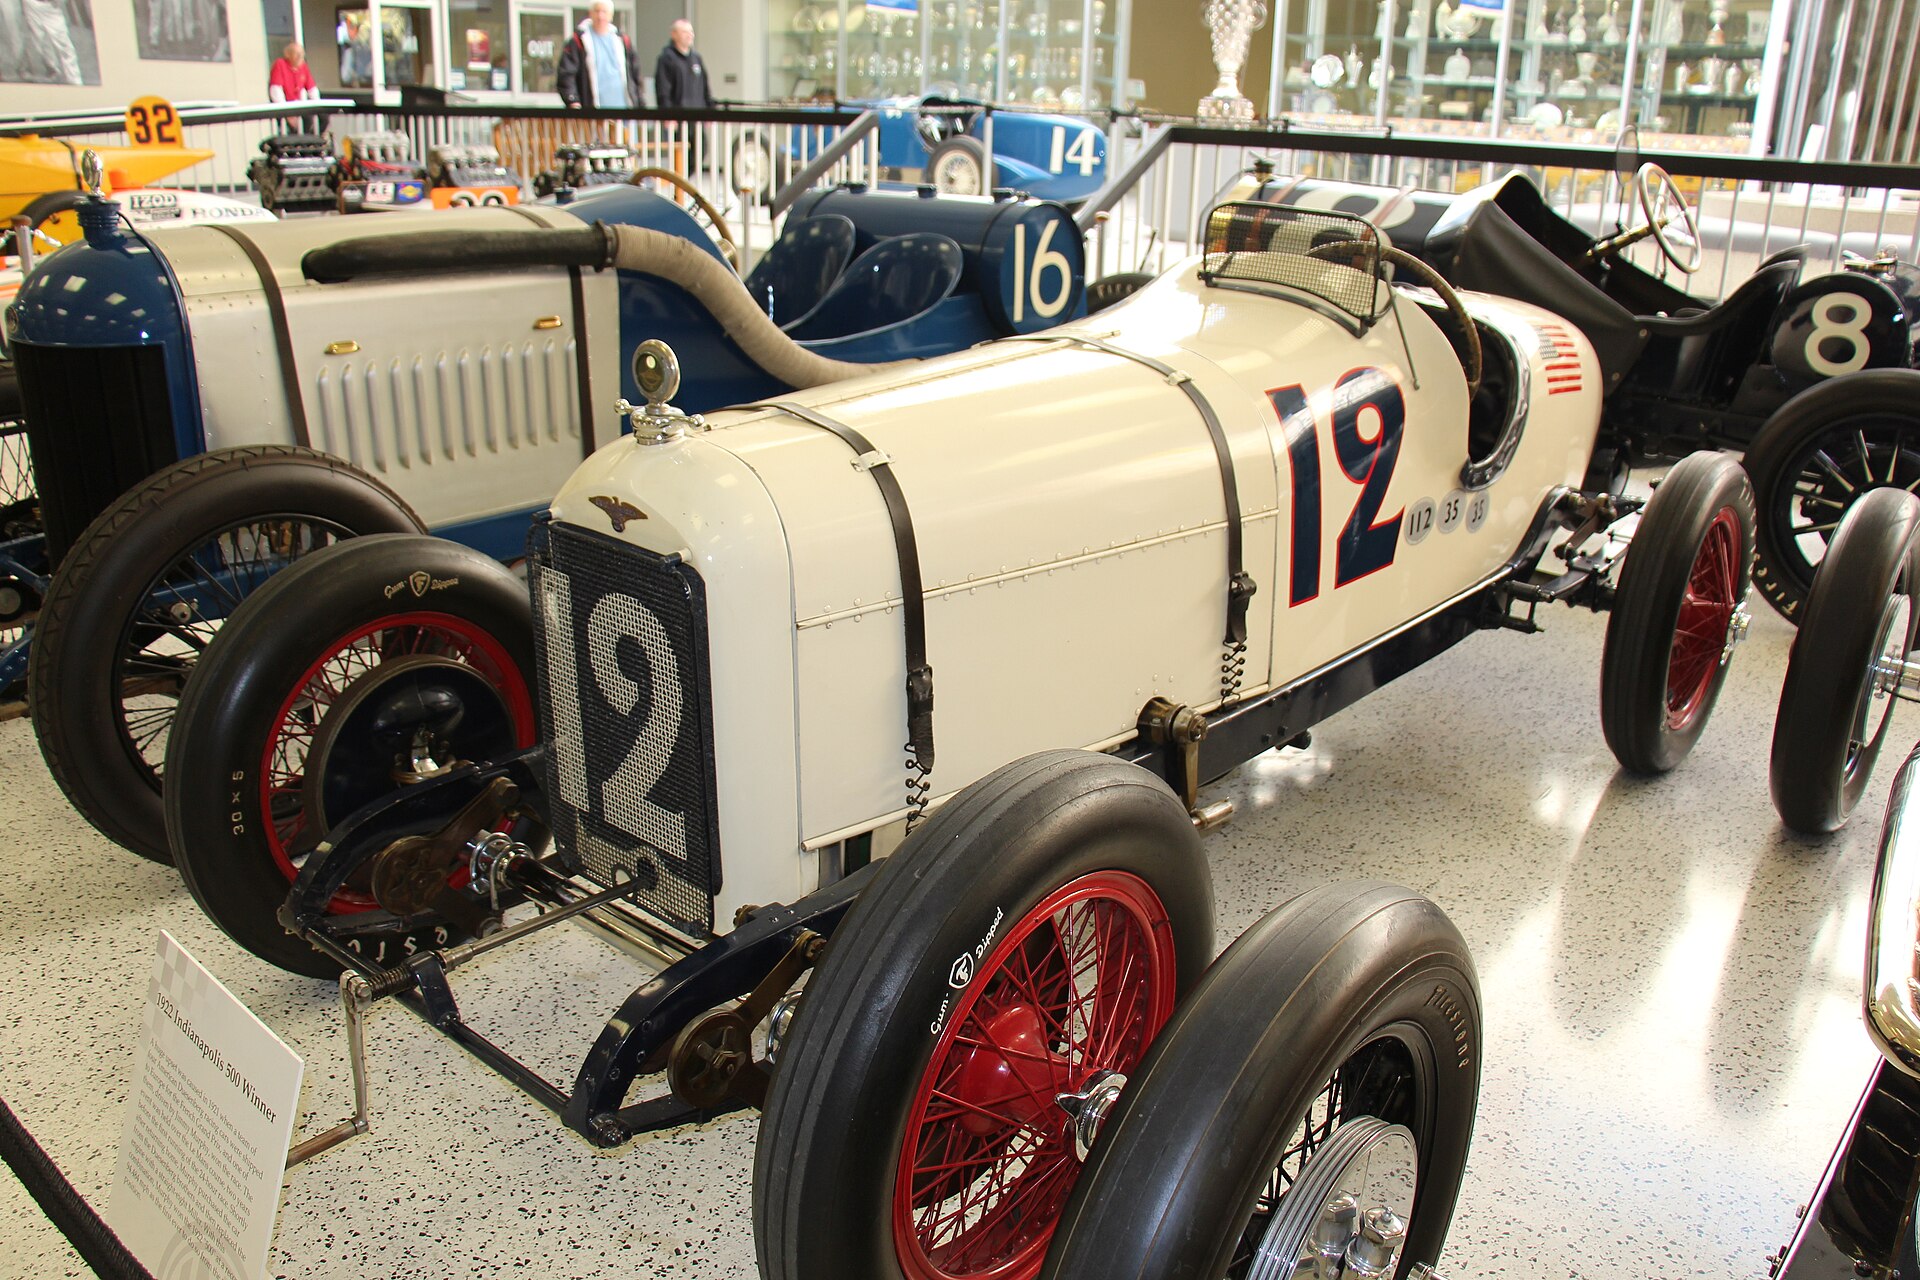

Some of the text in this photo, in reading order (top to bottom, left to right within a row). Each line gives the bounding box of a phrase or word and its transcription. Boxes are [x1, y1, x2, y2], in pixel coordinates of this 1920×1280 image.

[130, 105, 176, 143] 32
[1051, 125, 1101, 177] 14
[131, 194, 177, 209] IZOD
[1013, 218, 1072, 323] 16
[1805, 291, 1872, 377] 8
[1264, 366, 1405, 608] 12
[1409, 506, 1432, 536] 112
[1444, 498, 1459, 524] 35
[1471, 499, 1485, 524] 35
[541, 566, 687, 861] 12
[231, 770, 244, 781] 5
[231, 811, 245, 836] 30
[975, 905, 1004, 959] Dipped
[156, 992, 277, 1124] 1922 Indianapolis 500 Winner
